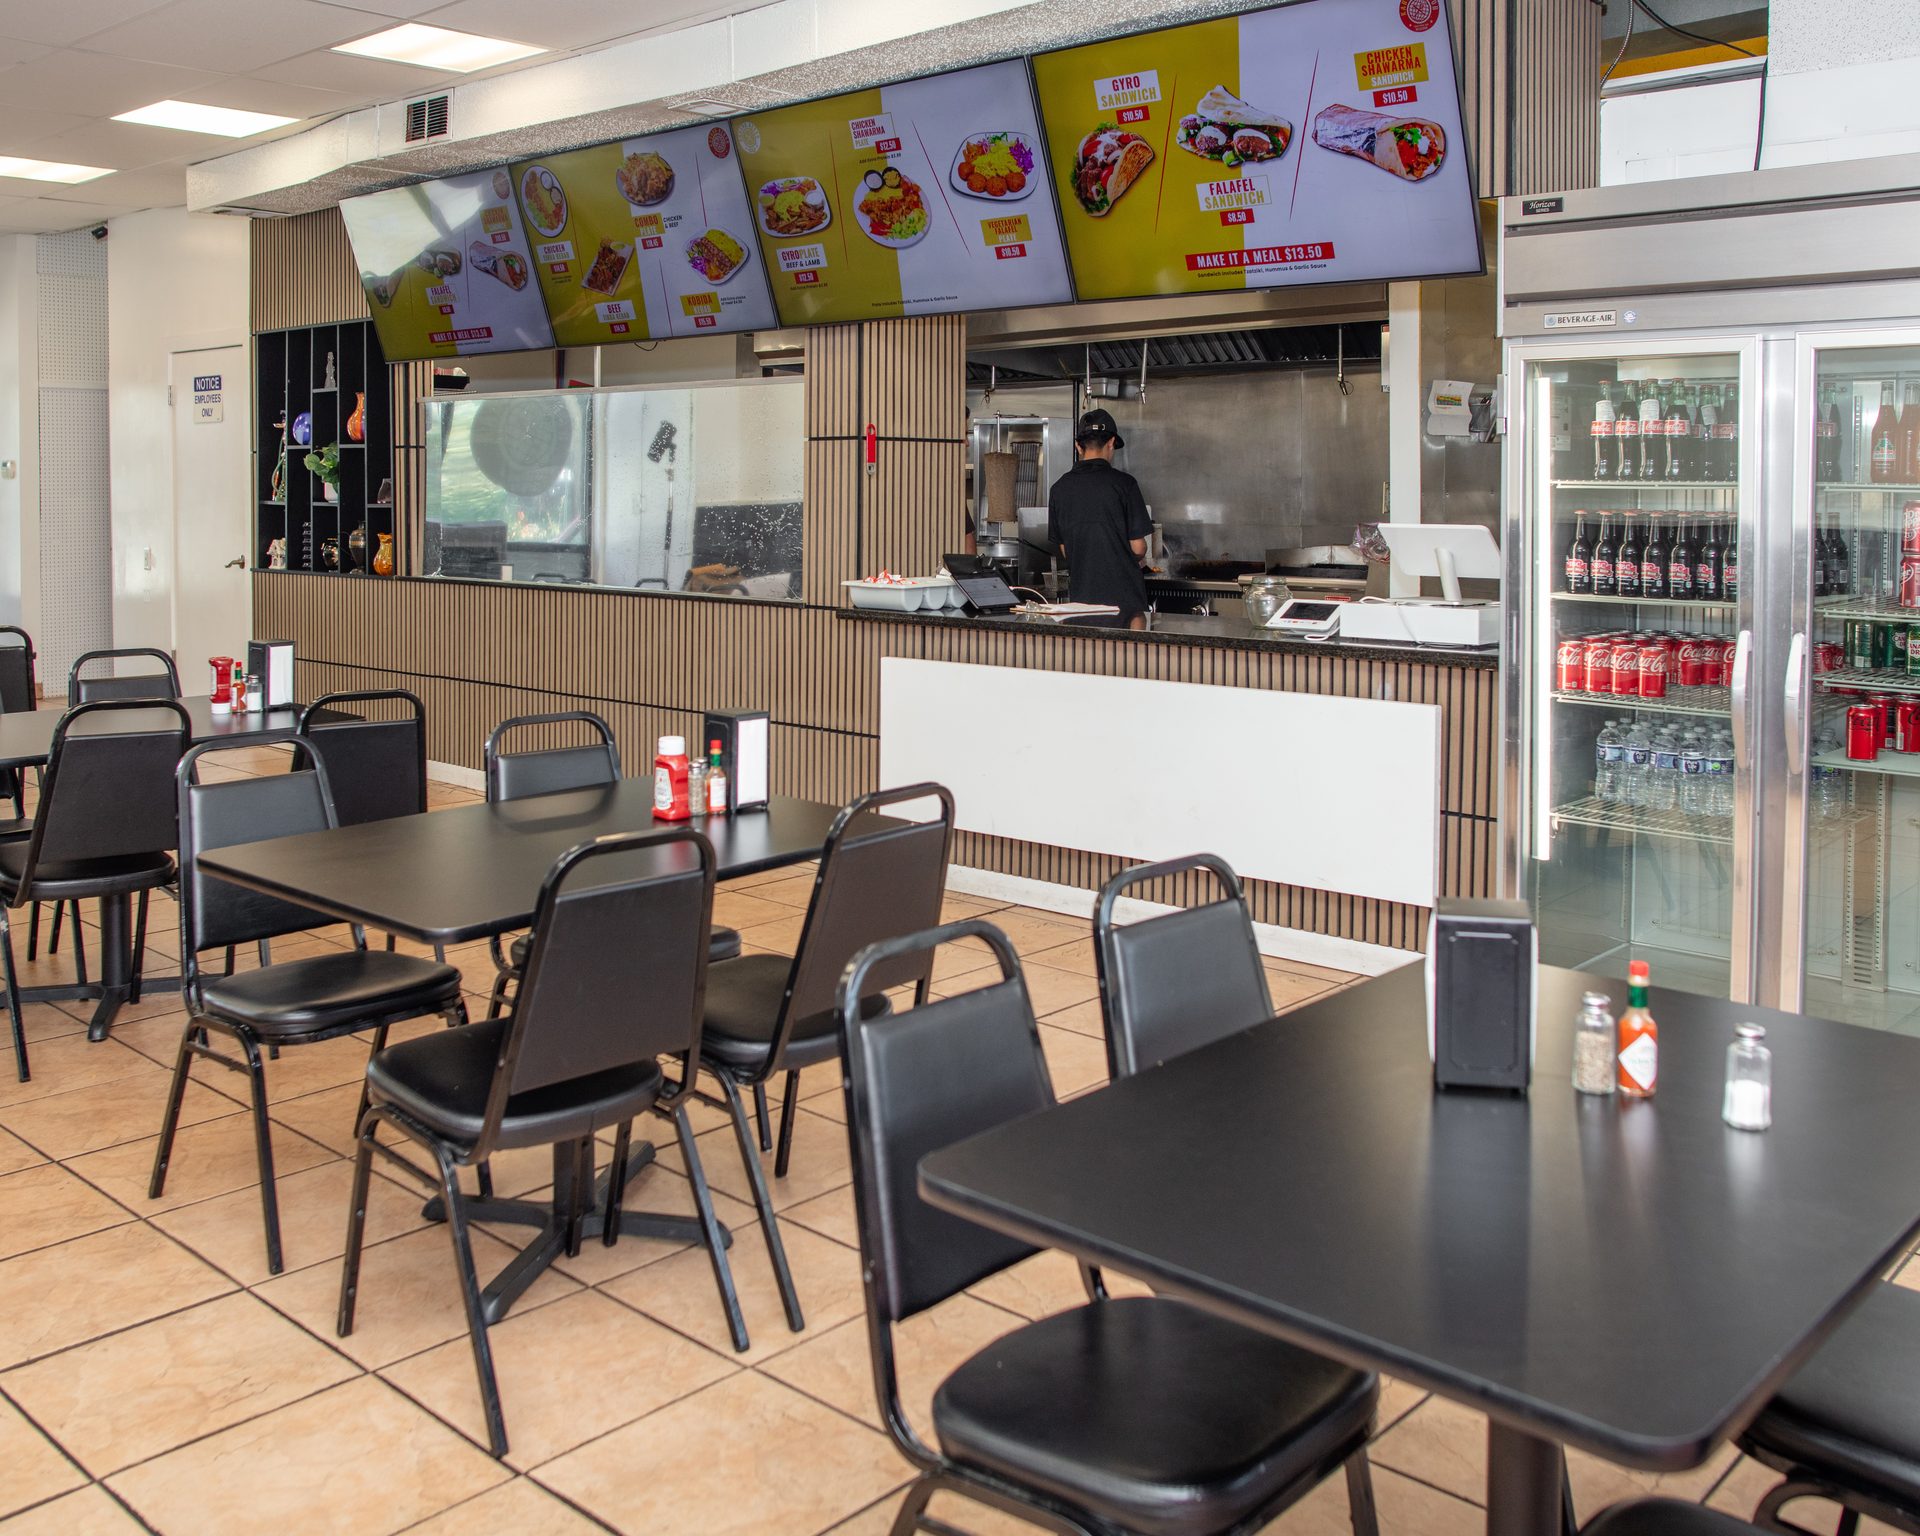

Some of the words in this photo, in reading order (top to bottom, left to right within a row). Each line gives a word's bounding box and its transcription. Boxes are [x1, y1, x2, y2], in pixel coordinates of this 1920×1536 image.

[1366, 46, 1413, 65] CHICKEN
[1361, 56, 1421, 77] SHAWARMA
[1112, 75, 1141, 92] GYRO
[1371, 70, 1415, 87] SANDWICH
[1101, 86, 1157, 108] SANDWICH
[1382, 89, 1408, 104] $10.50
[1122, 109, 1144, 122] $10.50
[851, 118, 876, 131] CHICKEN
[852, 126, 886, 140] SHAWARMA
[1209, 178, 1256, 196] FALAFEL
[1204, 190, 1265, 210] SANDWICH
[1529, 201, 1556, 210] Horizon
[635, 215, 659, 228] COMBO
[663, 215, 683, 223] CHICKEN
[987, 217, 1022, 229] VEGETARIAN
[1227, 211, 1247, 224] $8.50
[781, 250, 800, 261] GYRO
[1196, 255, 1226, 269] MAKE
[1228, 252, 1238, 266] IT
[1243, 250, 1250, 264] A
[1252, 248, 1283, 264] MEAL
[1284, 245, 1323, 261] $13.50
[786, 261, 799, 269] BEEF
[805, 259, 821, 267] LAMB
[607, 303, 622, 314] BEEF
[1557, 314, 1612, 324] BEVERAGE-AIR
[196, 377, 220, 391] NOTICE
[195, 393, 222, 404] EMPLOYEES
[202, 407, 214, 418] ONLY
